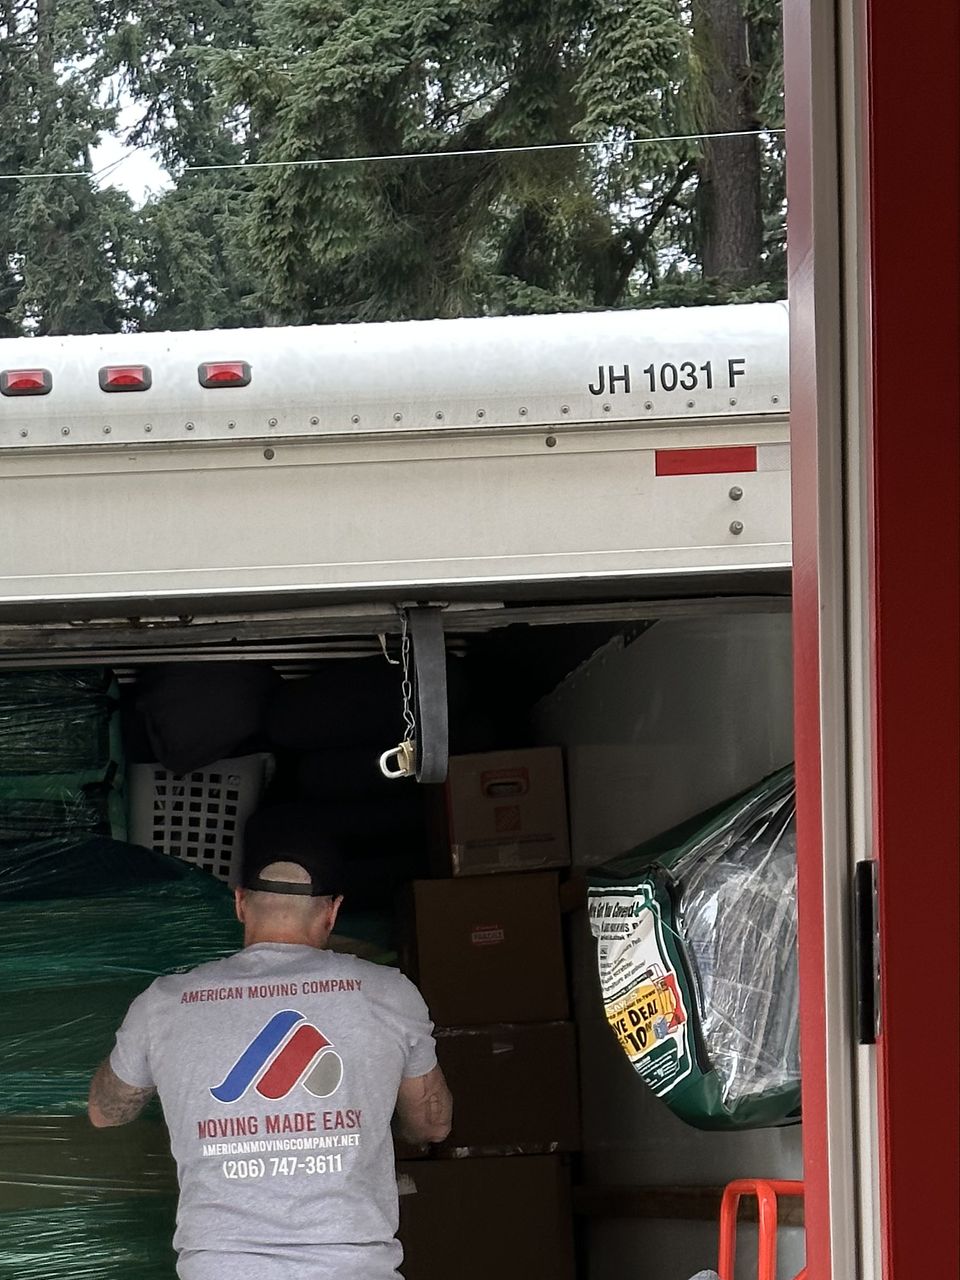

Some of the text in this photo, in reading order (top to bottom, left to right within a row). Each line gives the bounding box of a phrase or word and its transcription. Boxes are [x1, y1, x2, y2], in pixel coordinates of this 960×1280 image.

[588, 358, 746, 395] JH 1031 F
[180, 979, 362, 1004] AMERICAN MOVING COMPANY
[198, 1109, 362, 1139] MOVING MADE EASY
[202, 1134, 360, 1157] AMERICANMOVINGCOMPANY.NET
[223, 1154, 342, 1179] (206) 747-3611
